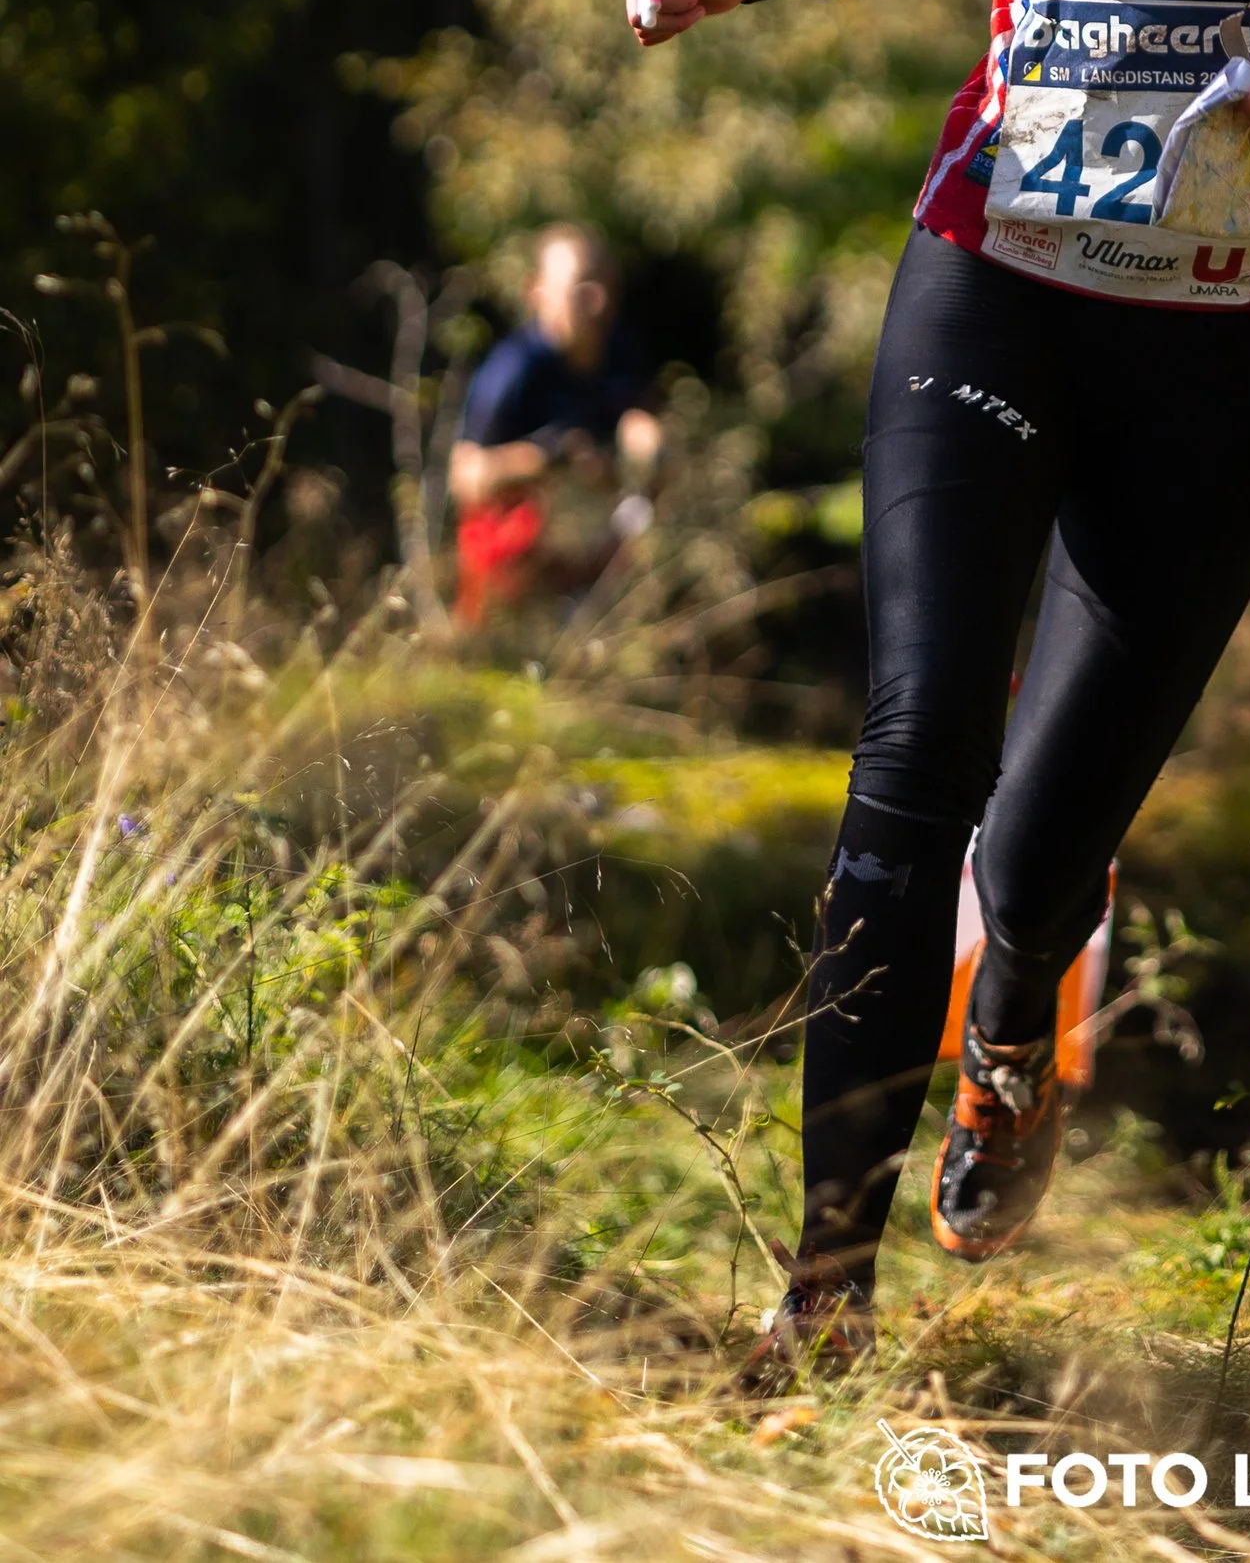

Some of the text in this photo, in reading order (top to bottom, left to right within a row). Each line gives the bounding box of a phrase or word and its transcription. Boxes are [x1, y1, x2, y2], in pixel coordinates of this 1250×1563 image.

[1050, 66, 1070, 82] SM
[1019, 119, 1163, 226] 42
[1002, 224, 1058, 254] Tisaren
[1076, 232, 1179, 271] Ullmax
[1189, 285, 1240, 297] UMARA
